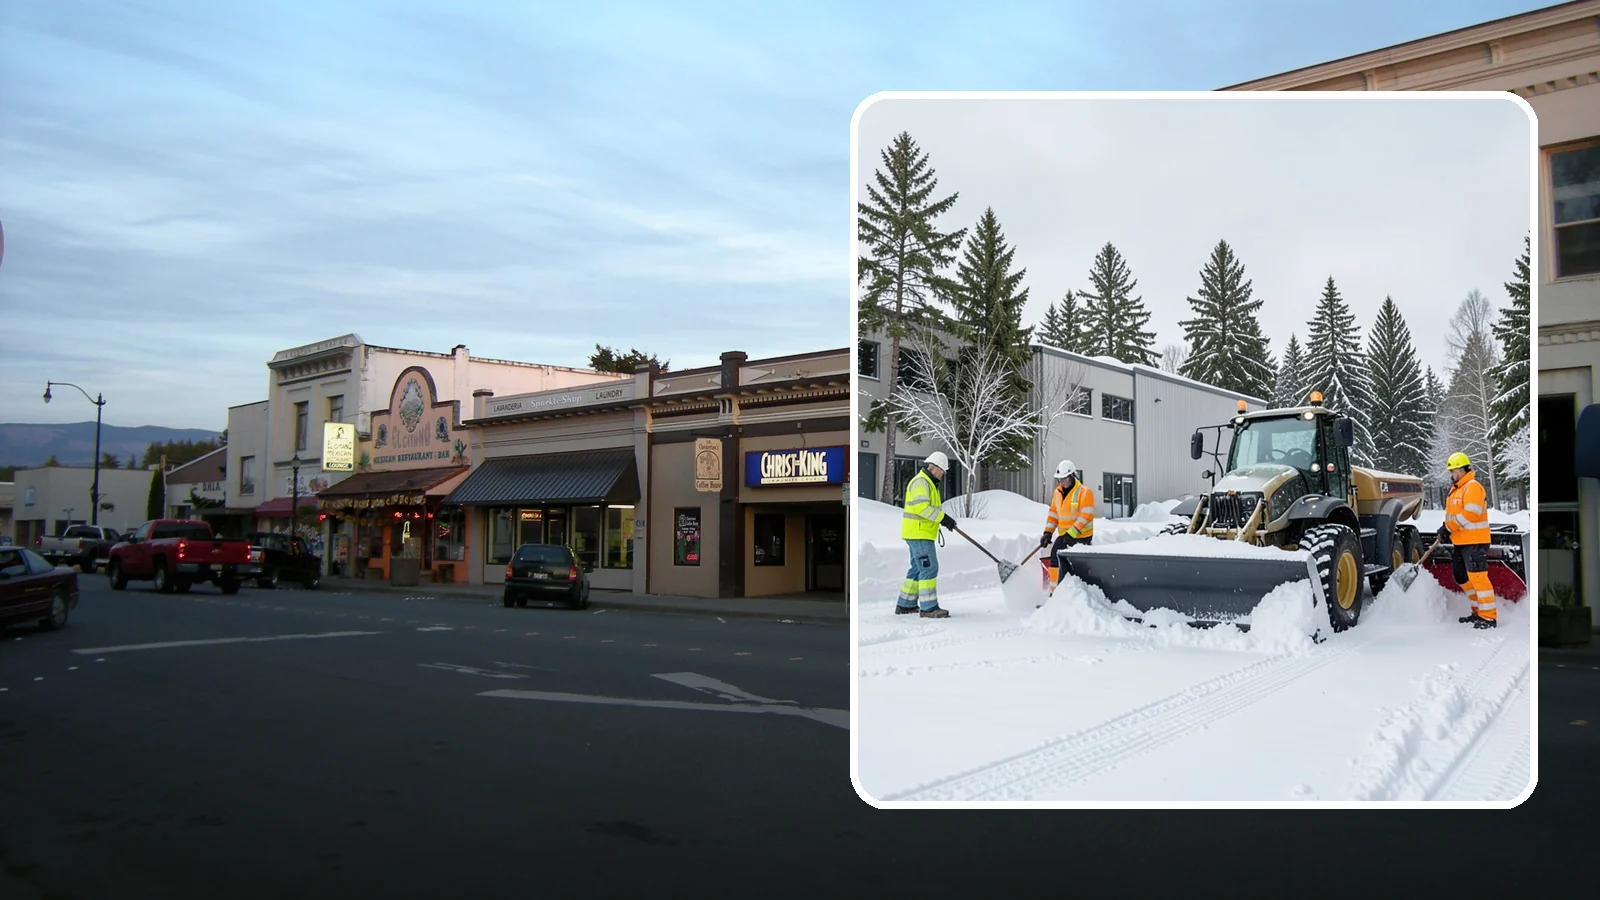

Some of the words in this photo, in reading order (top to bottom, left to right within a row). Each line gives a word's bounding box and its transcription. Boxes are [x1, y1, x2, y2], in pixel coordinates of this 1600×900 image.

[562, 394, 582, 405] Shop
[595, 389, 623, 400] LAUNDRY
[493, 402, 522, 412] LAVANDERIA
[373, 455, 396, 464] MEXICAN
[397, 451, 433, 462] RESTAURANT
[438, 450, 450, 459] BAR
[761, 452, 797, 478] CHRIST
[799, 450, 827, 476] KING
